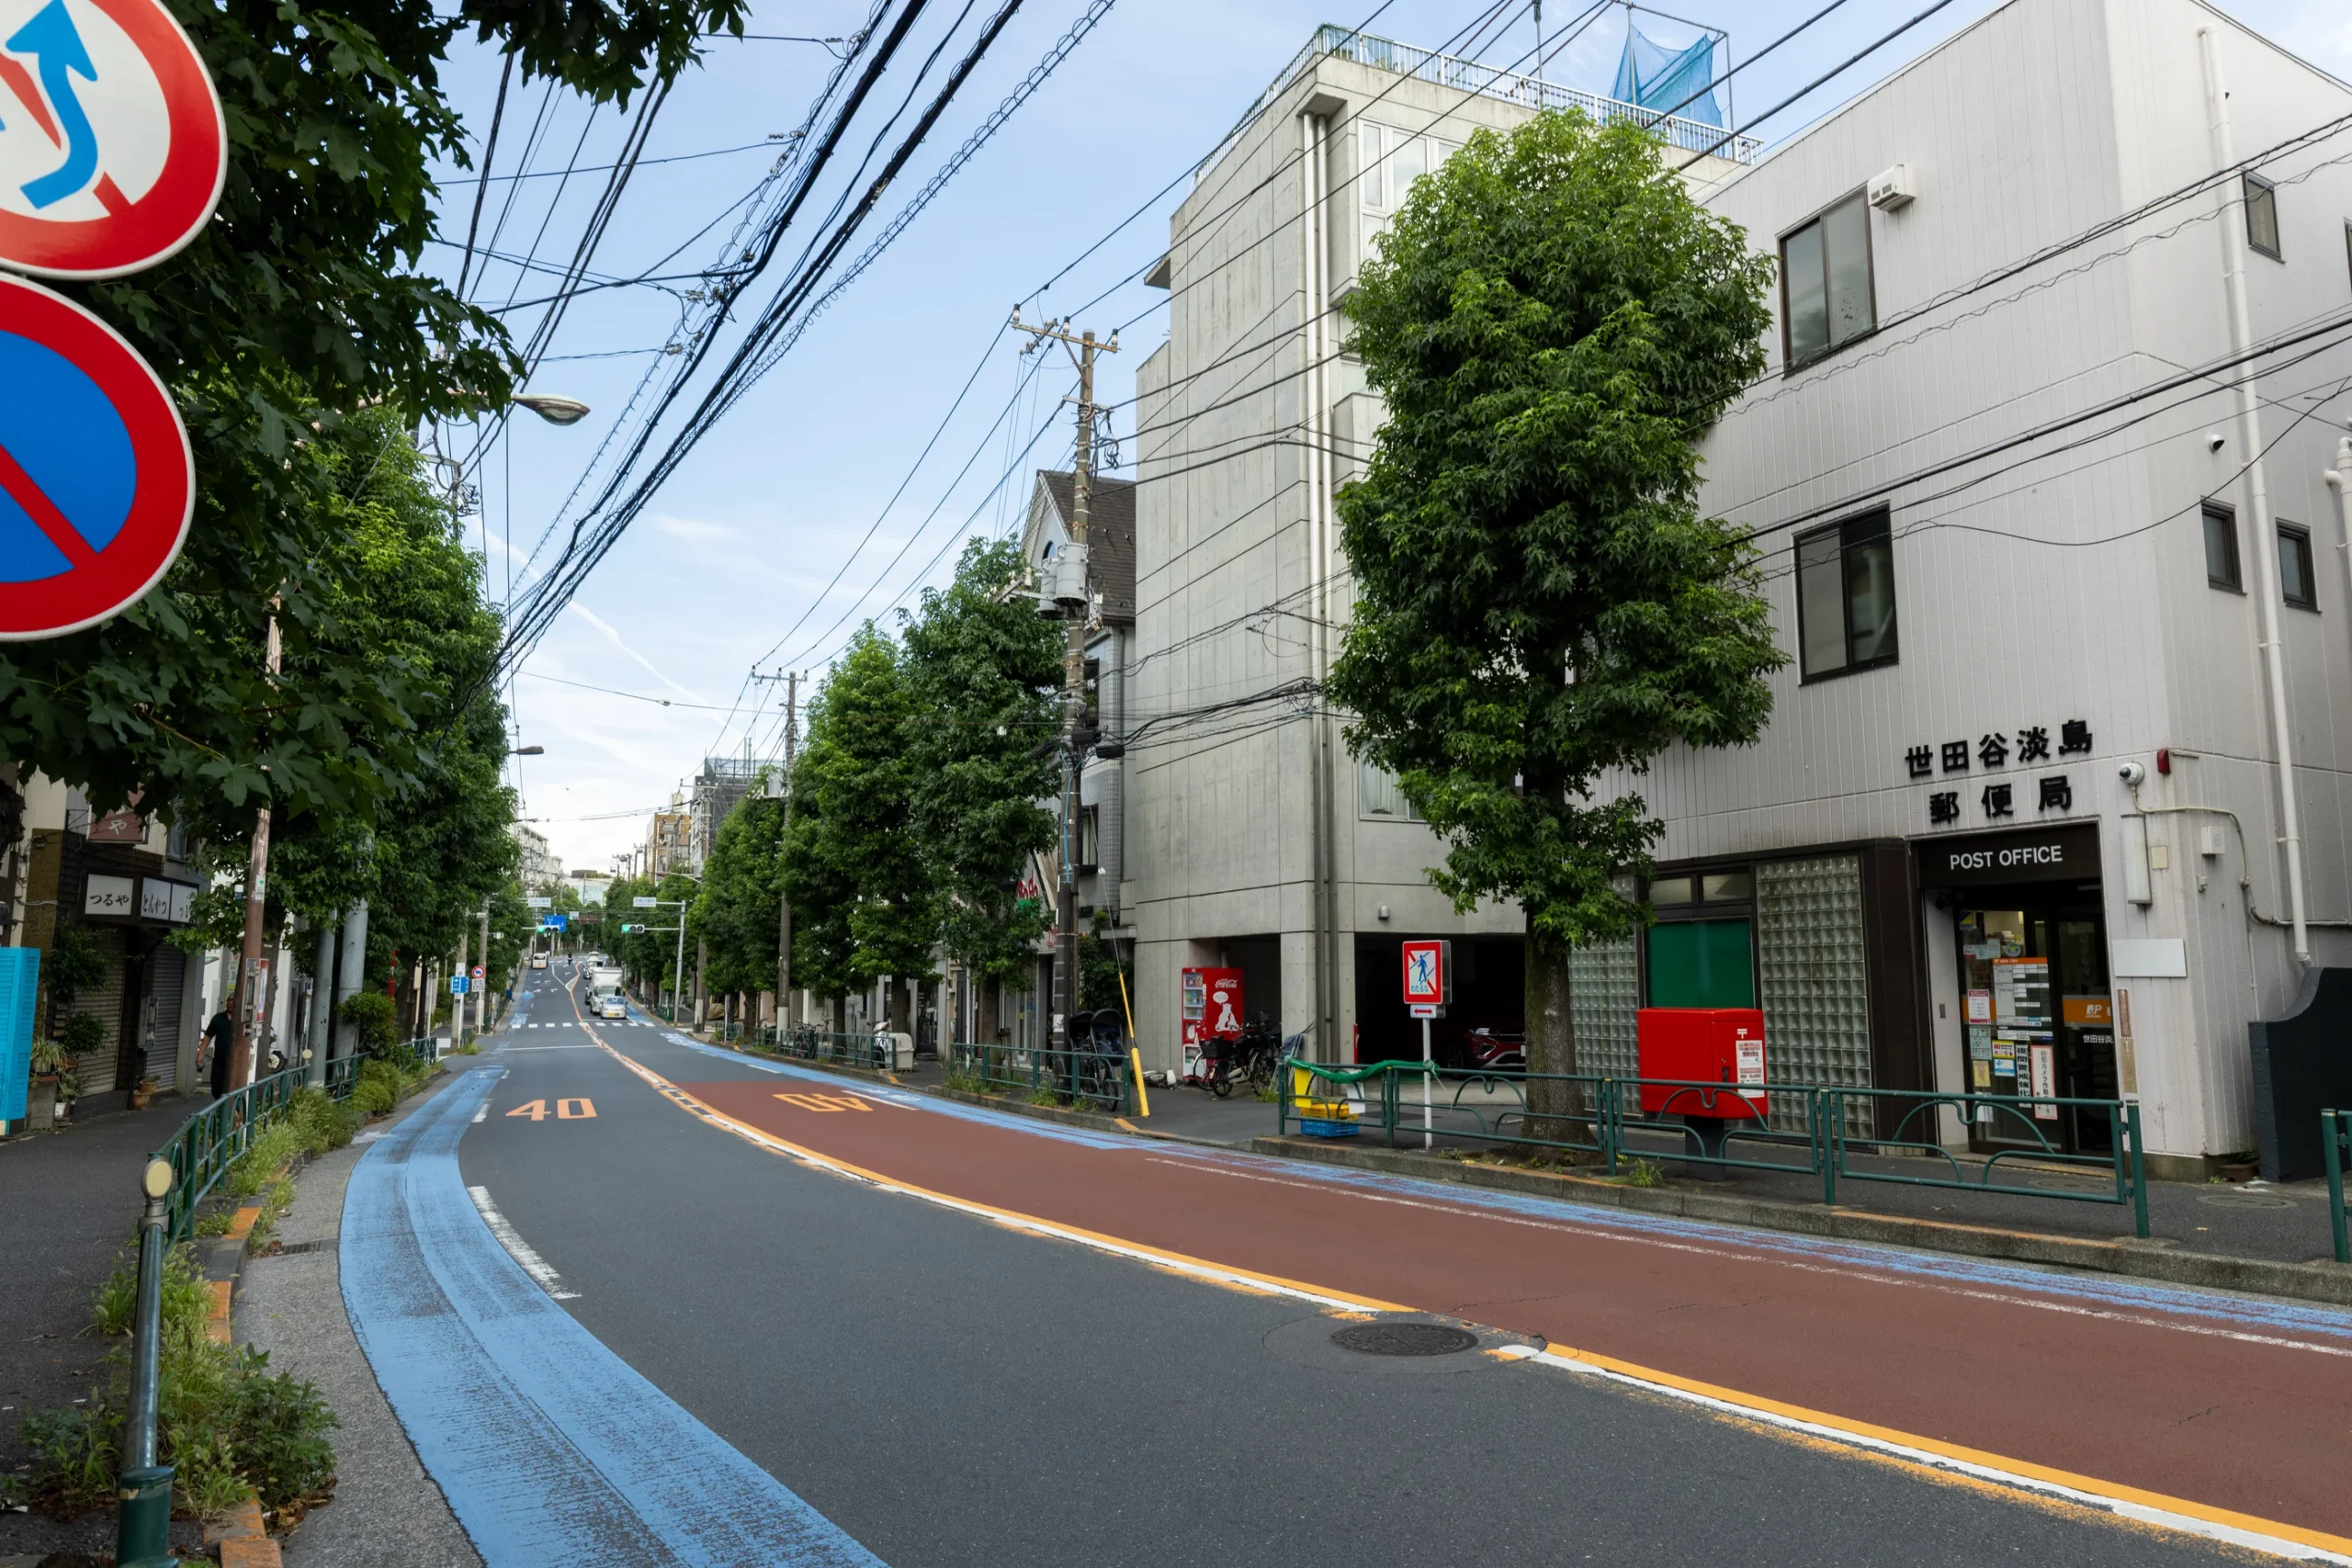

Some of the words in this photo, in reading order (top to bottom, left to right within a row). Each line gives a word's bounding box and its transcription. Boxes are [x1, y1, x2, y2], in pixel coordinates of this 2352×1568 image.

[1905, 720, 2093, 778] 世田谷淡島
[1929, 775, 2072, 824] 郵便局
[1950, 852, 1994, 870] POST
[1998, 845, 2063, 866] OFFICE
[89, 894, 130, 907] つるや
[142, 894, 167, 914] とんかつ
[2017, 1048, 2030, 1105] 夜間警戒強化
[505, 1099, 597, 1121] 40
[773, 1093, 874, 1111] 40
